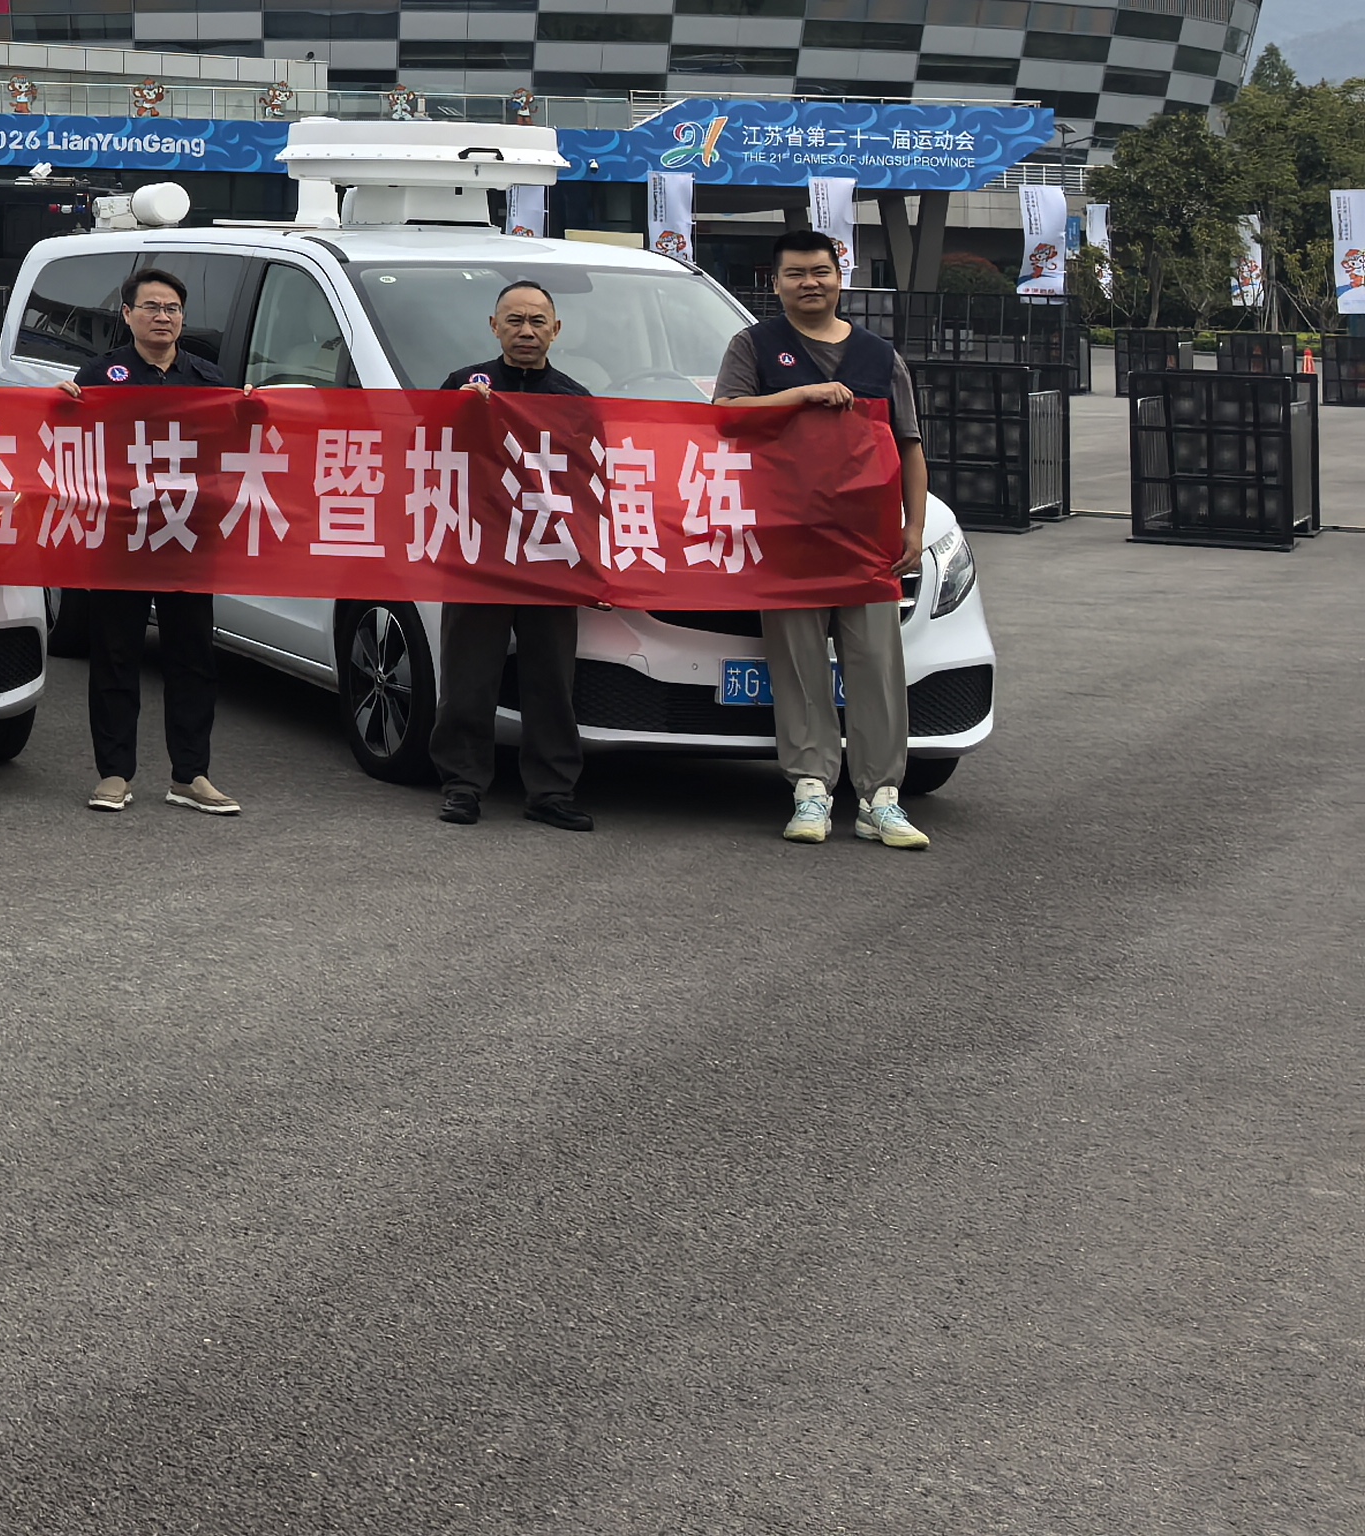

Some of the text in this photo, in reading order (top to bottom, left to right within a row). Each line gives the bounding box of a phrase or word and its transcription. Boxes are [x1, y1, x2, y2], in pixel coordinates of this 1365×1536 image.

[47, 131, 206, 157] LianYunGang
[742, 125, 975, 151] 江苏省第二十一届运动会
[743, 152, 766, 162] THE
[793, 153, 837, 164] GAMES
[839, 154, 856, 165] OF
[858, 155, 912, 166] JIANGSU
[914, 156, 976, 168] PROVINCE
